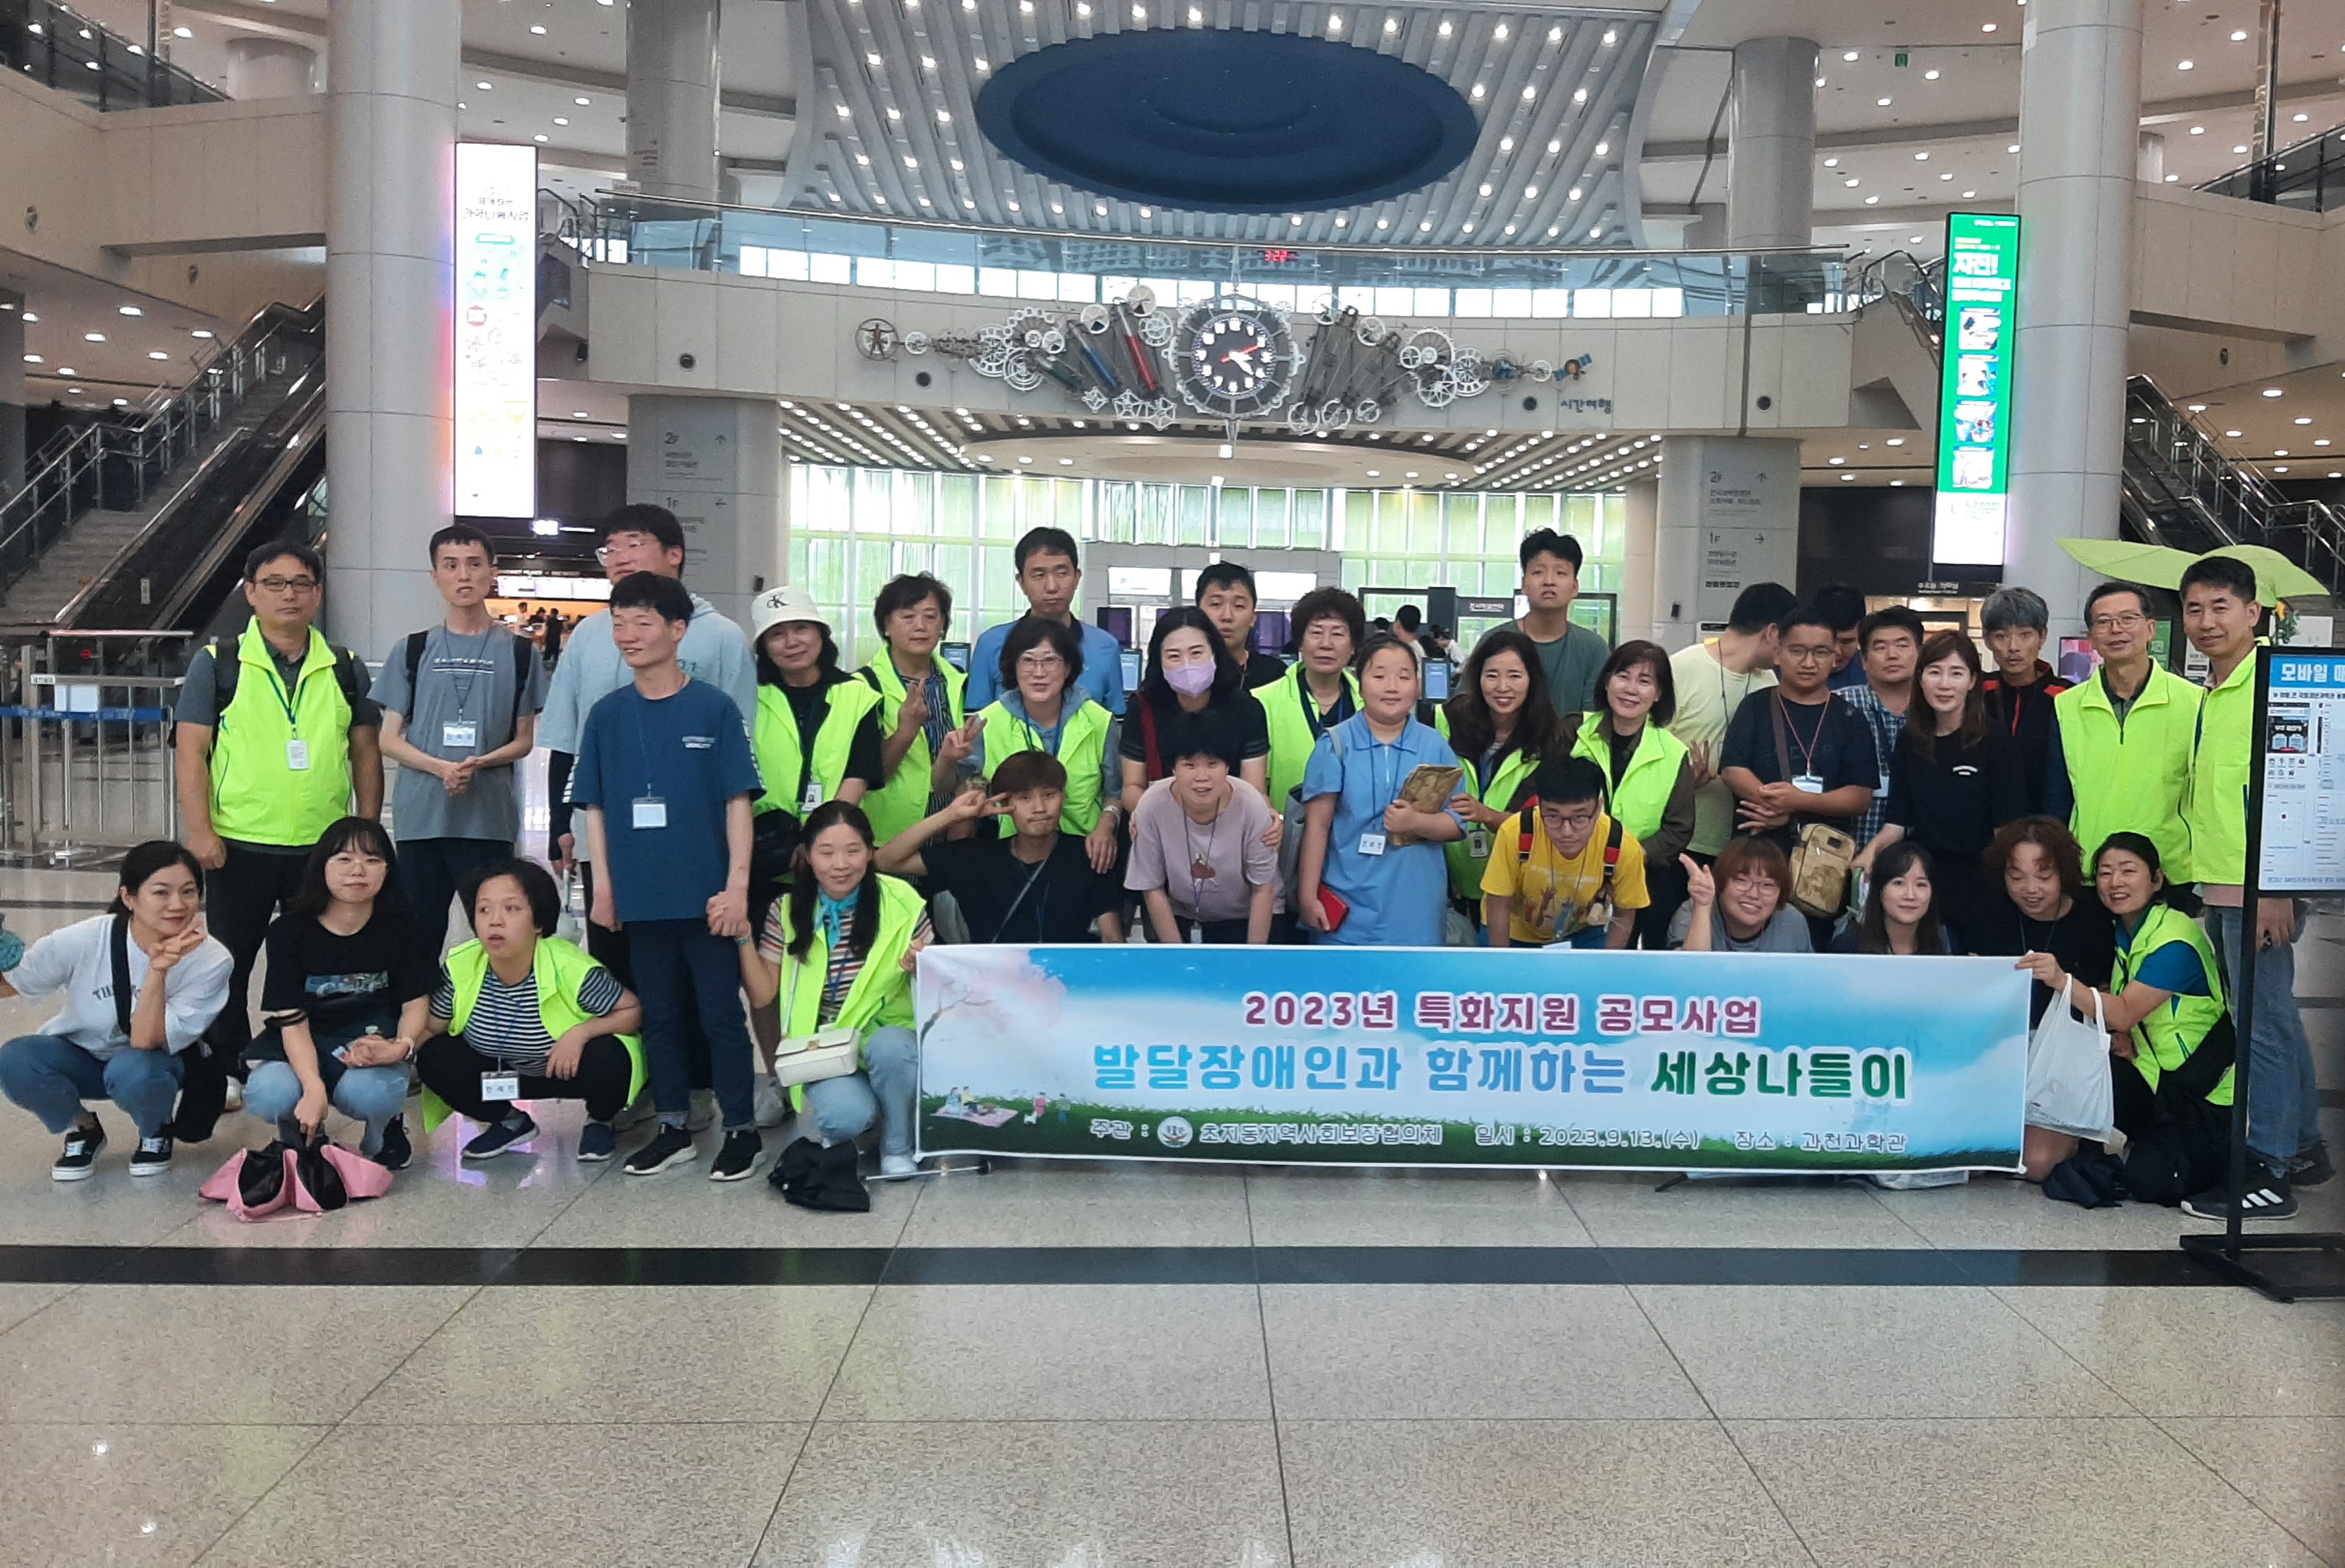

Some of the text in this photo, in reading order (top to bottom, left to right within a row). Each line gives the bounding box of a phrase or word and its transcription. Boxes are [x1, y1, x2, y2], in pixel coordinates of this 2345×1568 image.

[2281, 663, 2328, 683] 모바일
[1246, 995, 1757, 1035] 2023년 특화지원 공모사업
[1095, 1044, 1909, 1100] 발달장애인과 함께하는 세상나들이
[1091, 1120, 1133, 1138] 주관
[1475, 1126, 1513, 1146] 일시
[1735, 1130, 1776, 1150] 장소
[1801, 1131, 1907, 1153] 과천과학관
